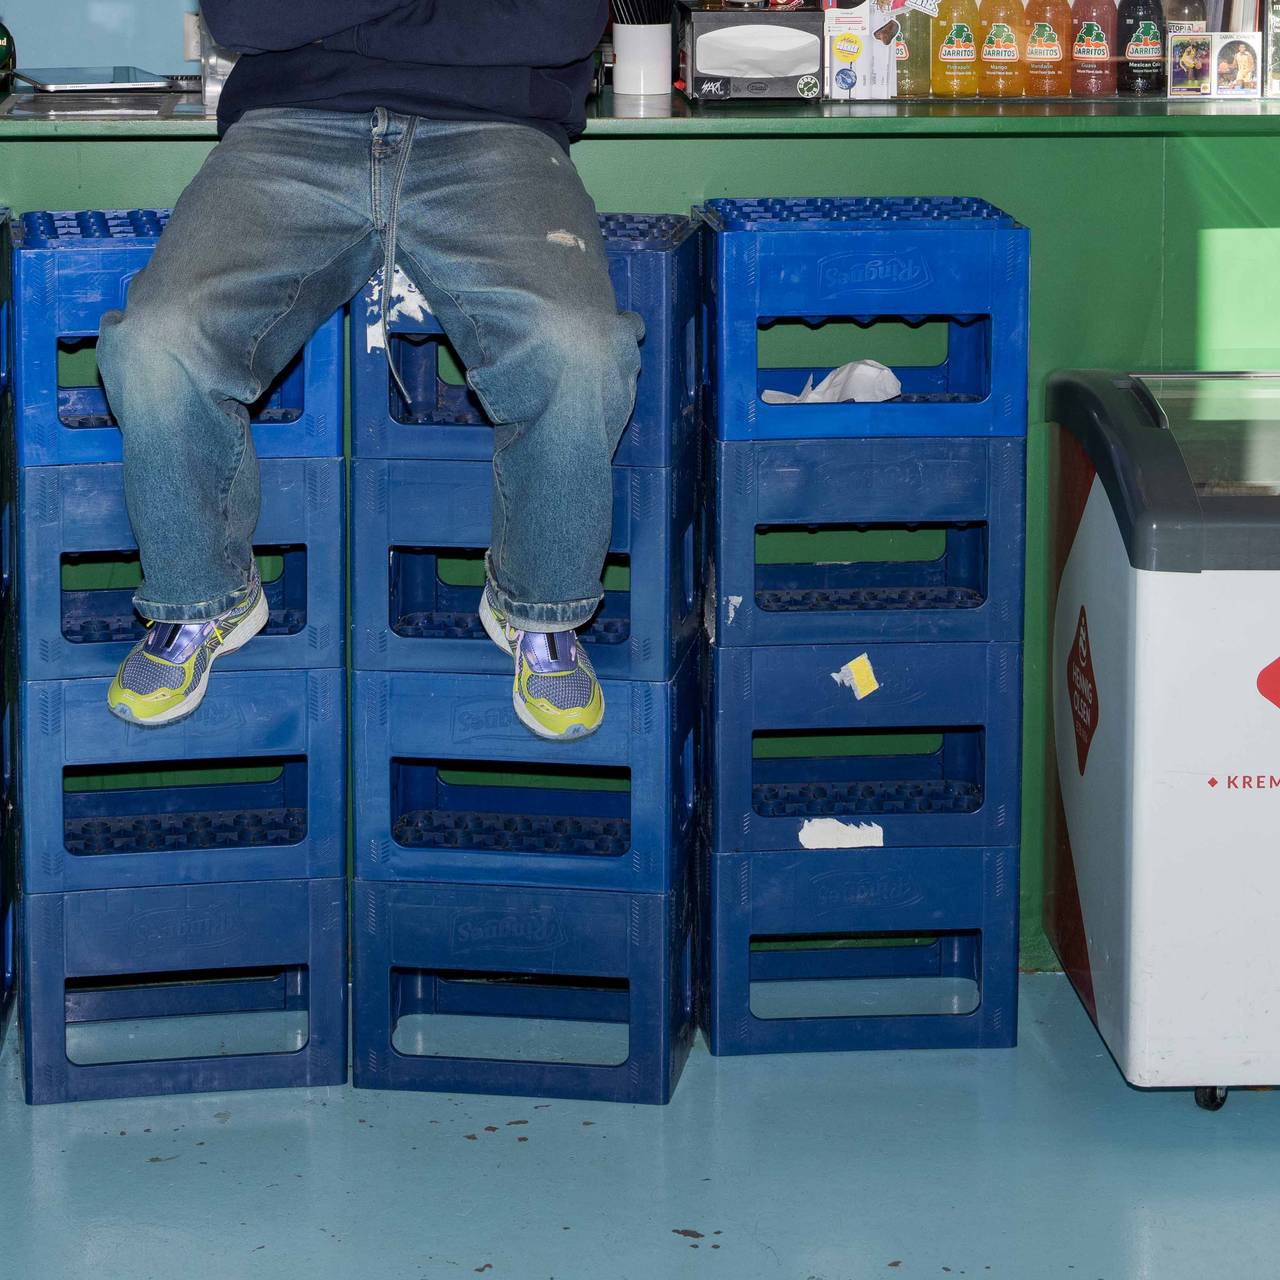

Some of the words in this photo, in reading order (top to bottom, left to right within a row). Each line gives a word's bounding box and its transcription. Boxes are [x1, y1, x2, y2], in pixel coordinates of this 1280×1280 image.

[942, 48, 976, 58] JARRITOS
[983, 48, 1016, 58] JARRITOS
[1027, 48, 1059, 58] JARRITOS
[1074, 48, 1106, 58] JARRITOS
[1129, 48, 1162, 58] JARRITOS
